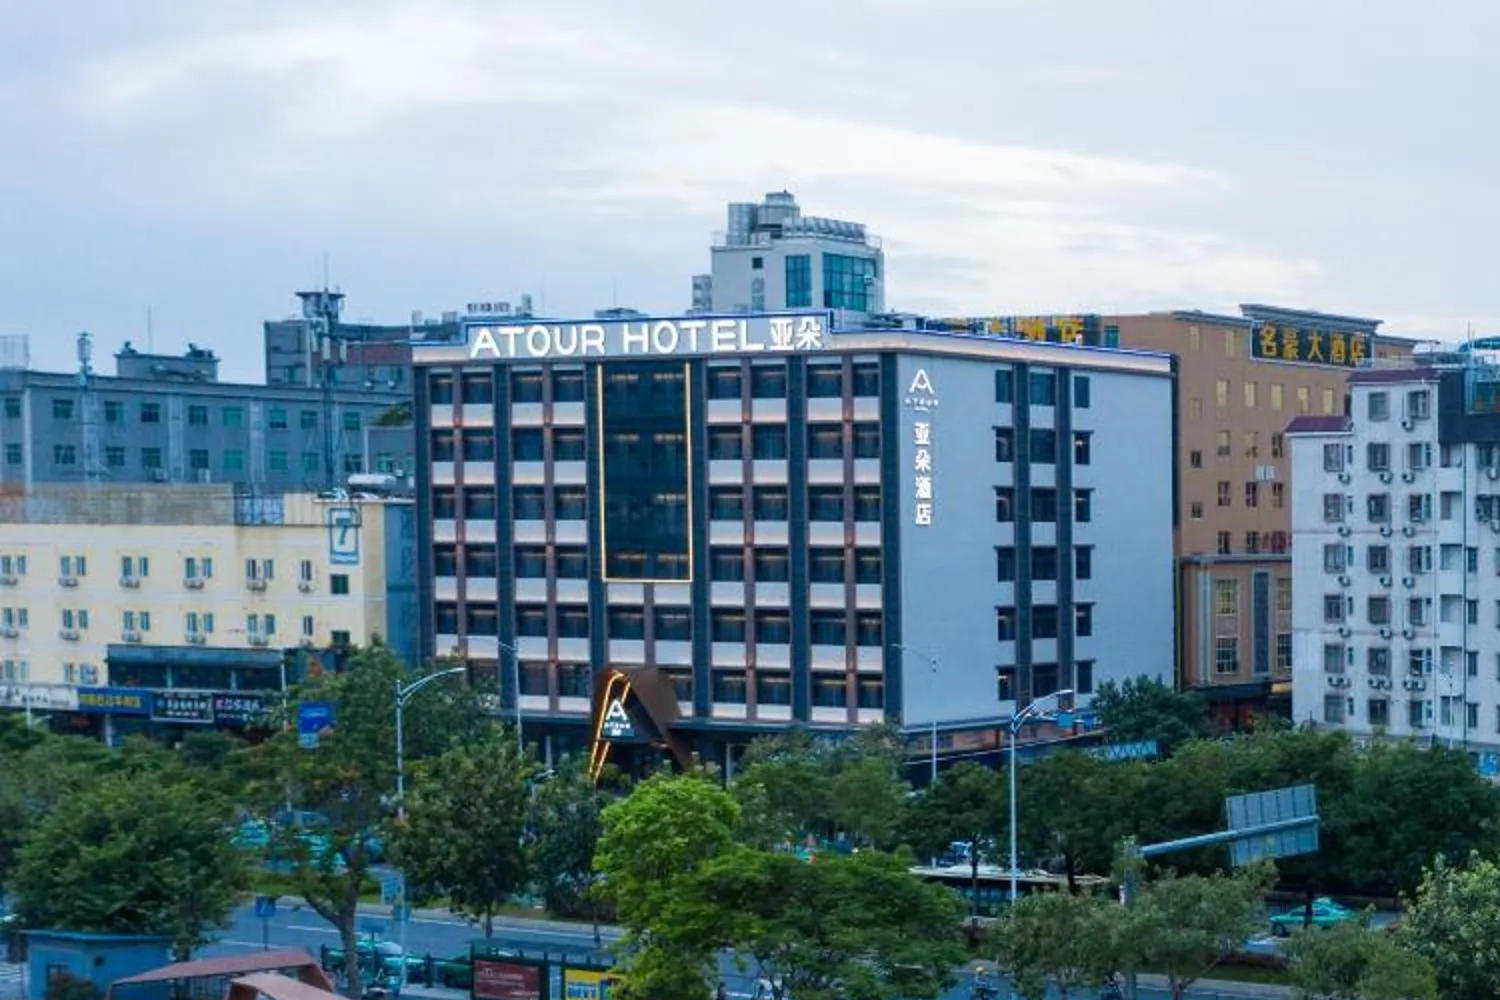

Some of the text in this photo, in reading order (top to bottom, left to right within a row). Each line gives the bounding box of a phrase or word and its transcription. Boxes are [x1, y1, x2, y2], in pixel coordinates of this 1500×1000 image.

[470, 319, 765, 358] ATOUR HOTEL
[769, 316, 823, 352] 亚朵
[914, 421, 932, 525] 亚朵酒店
